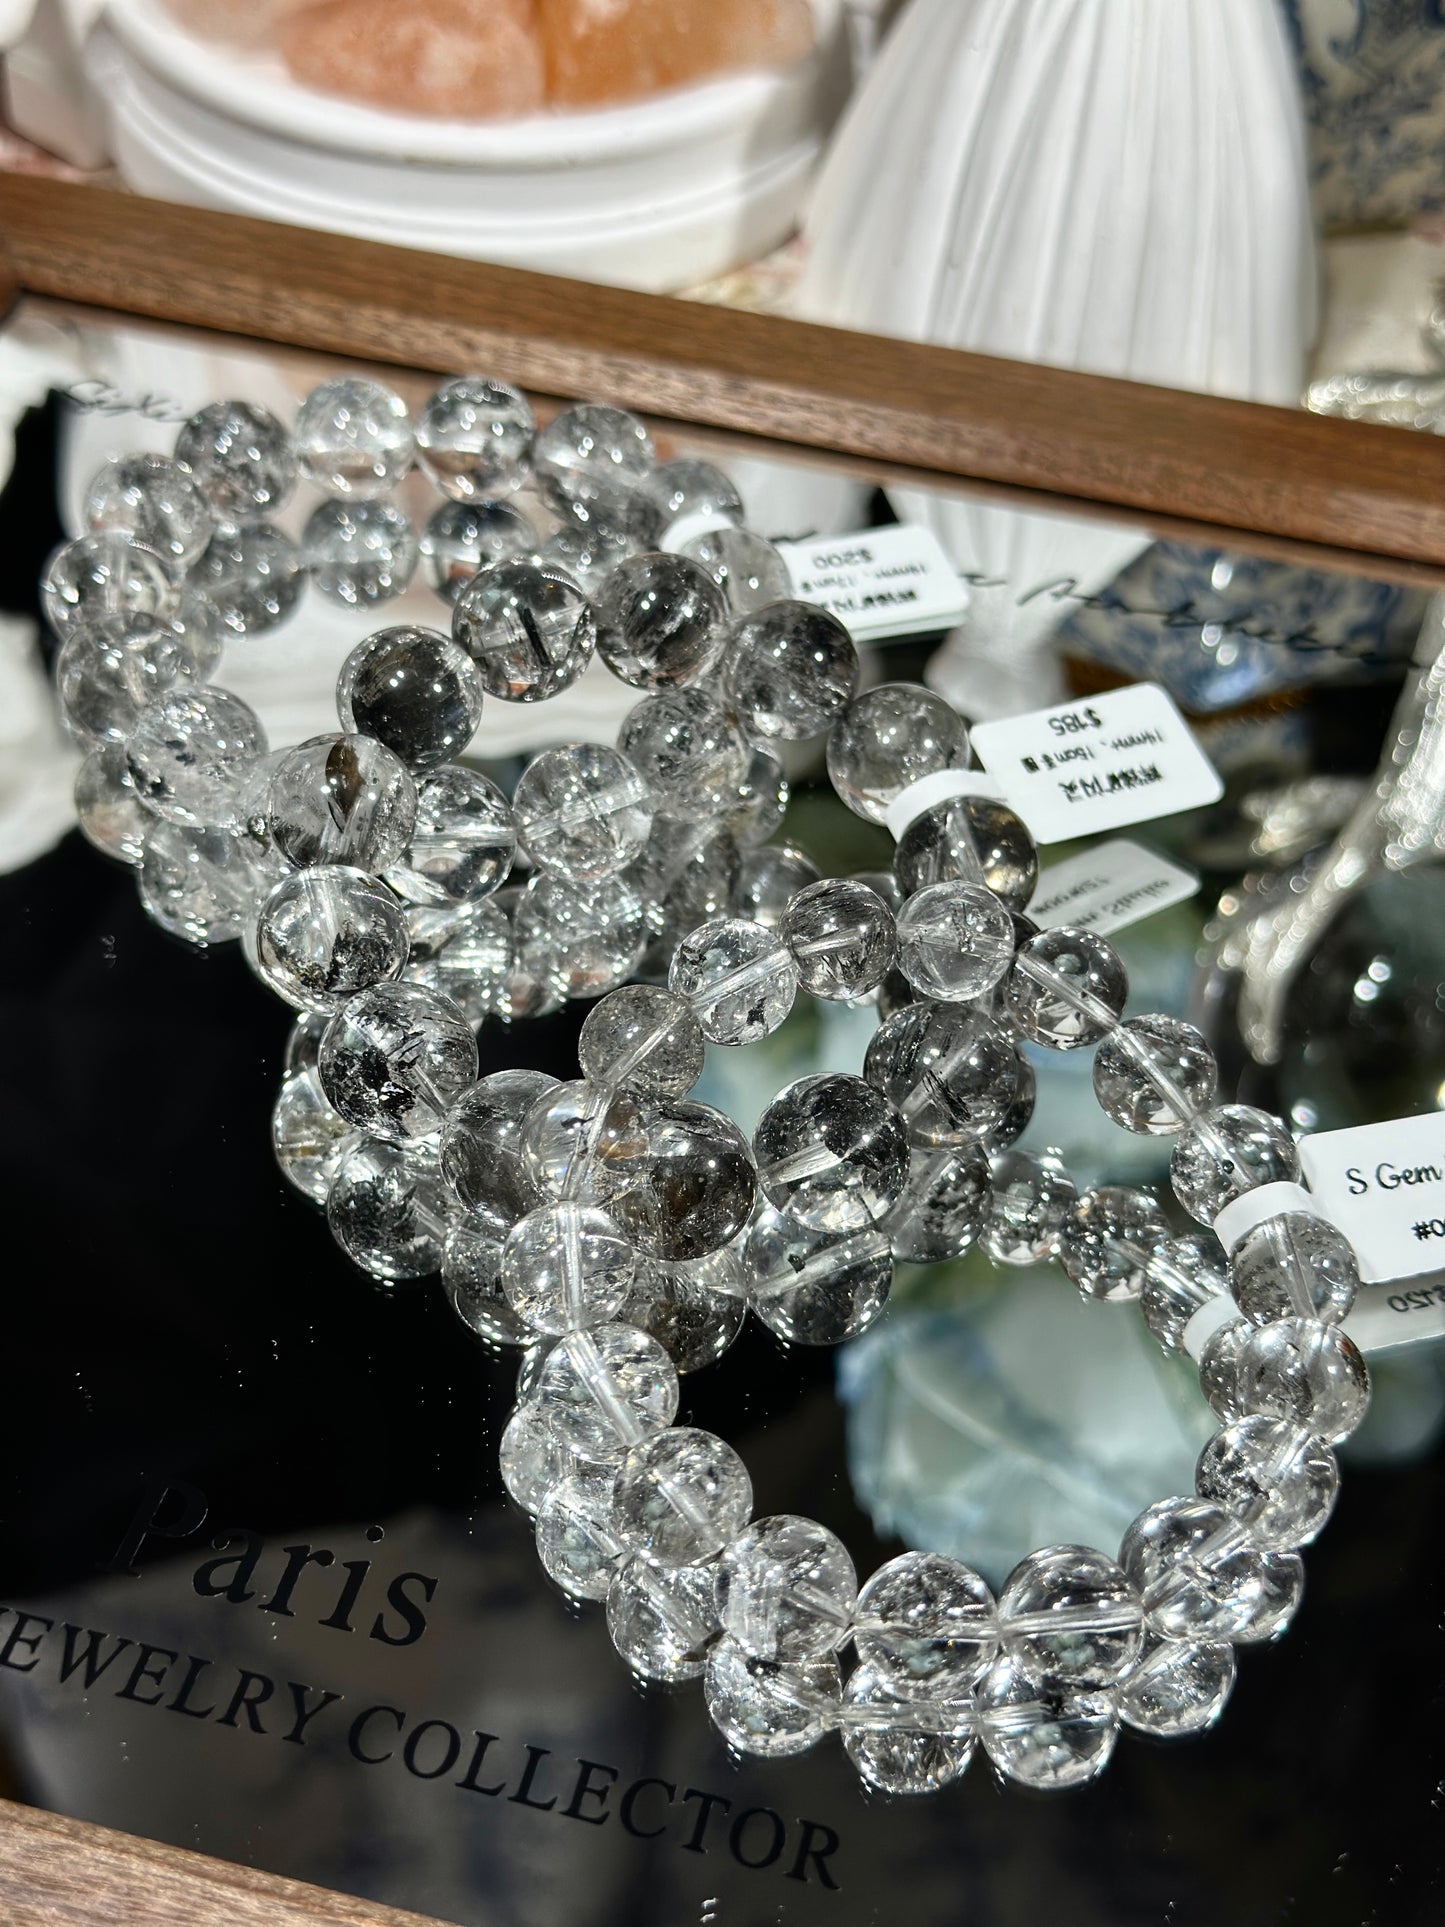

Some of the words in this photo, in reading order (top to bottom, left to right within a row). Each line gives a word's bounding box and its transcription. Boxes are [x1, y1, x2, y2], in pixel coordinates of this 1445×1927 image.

[1048, 707, 1102, 736] $185
[1346, 1168, 1368, 1195] S
[1375, 1162, 1442, 1190] Gem
[100, 1478, 439, 1646] Paris
[0, 1607, 343, 1745] EWELRY
[347, 1704, 842, 1890] COLLECTOR
